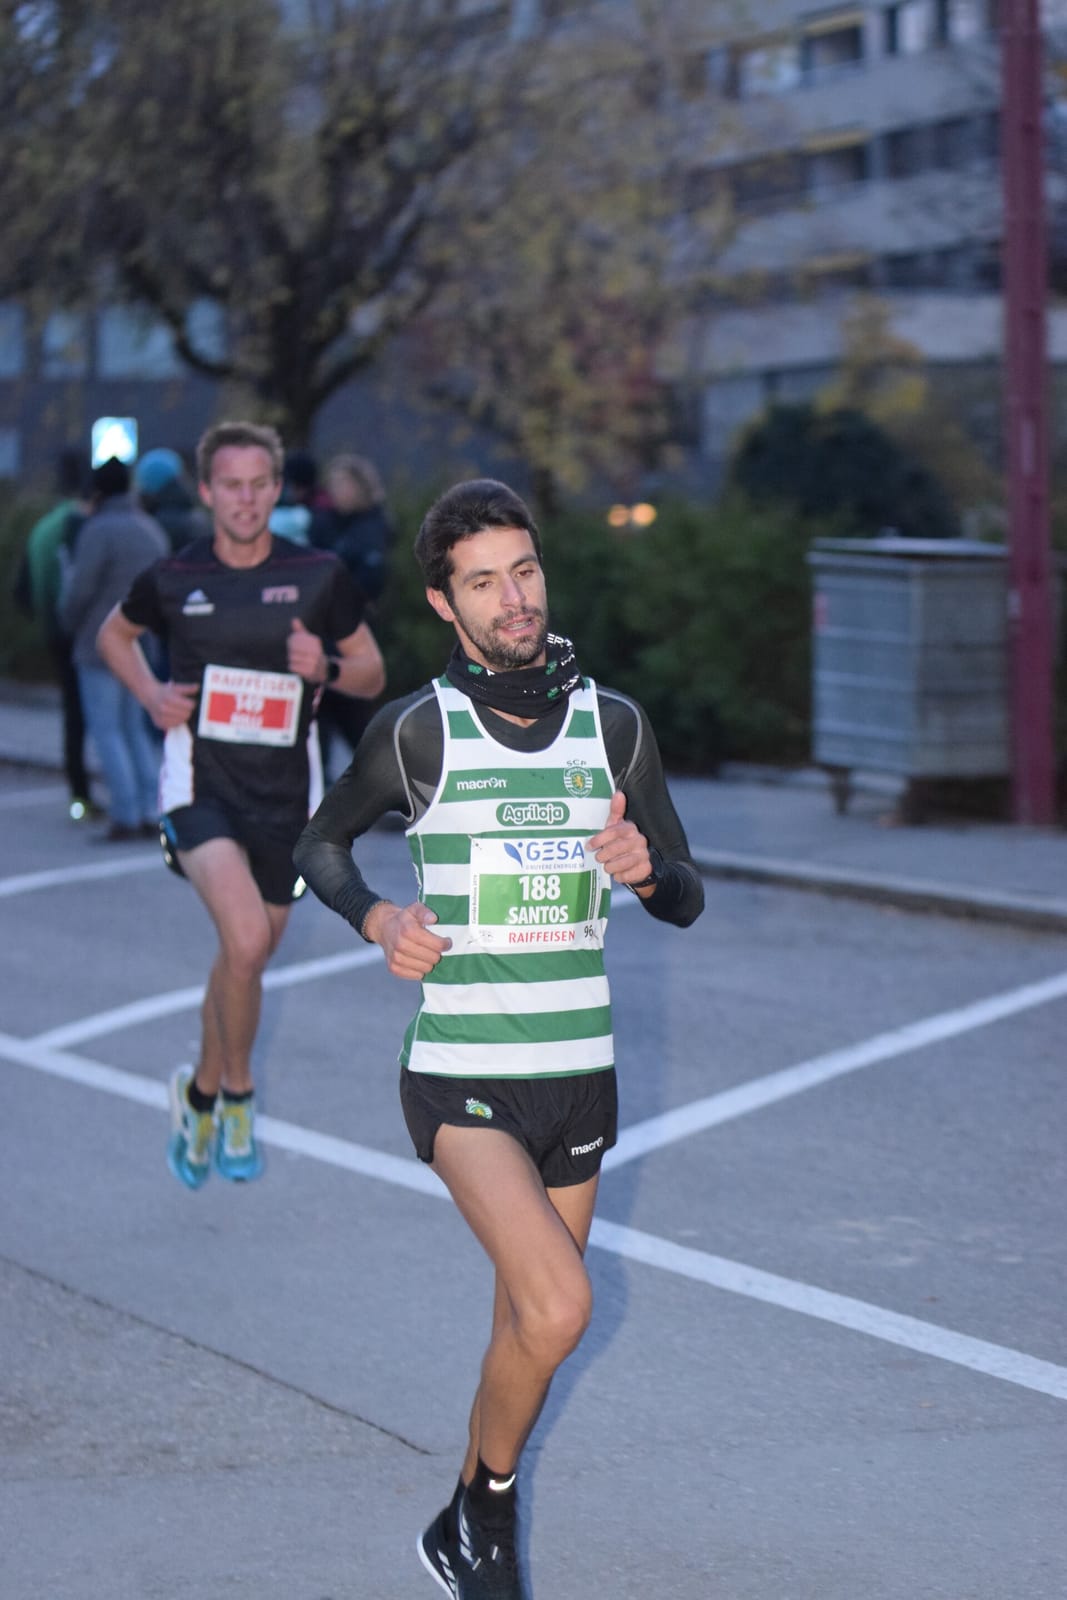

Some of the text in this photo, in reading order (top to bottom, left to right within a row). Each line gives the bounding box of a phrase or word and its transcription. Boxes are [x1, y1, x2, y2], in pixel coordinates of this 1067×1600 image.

[456, 777, 508, 791] macron
[503, 803, 562, 823] Agriloja
[526, 840, 585, 861] GESA
[519, 874, 561, 902] 188
[507, 905, 569, 924] SANTOS
[508, 930, 576, 945] RAIFFEISEN
